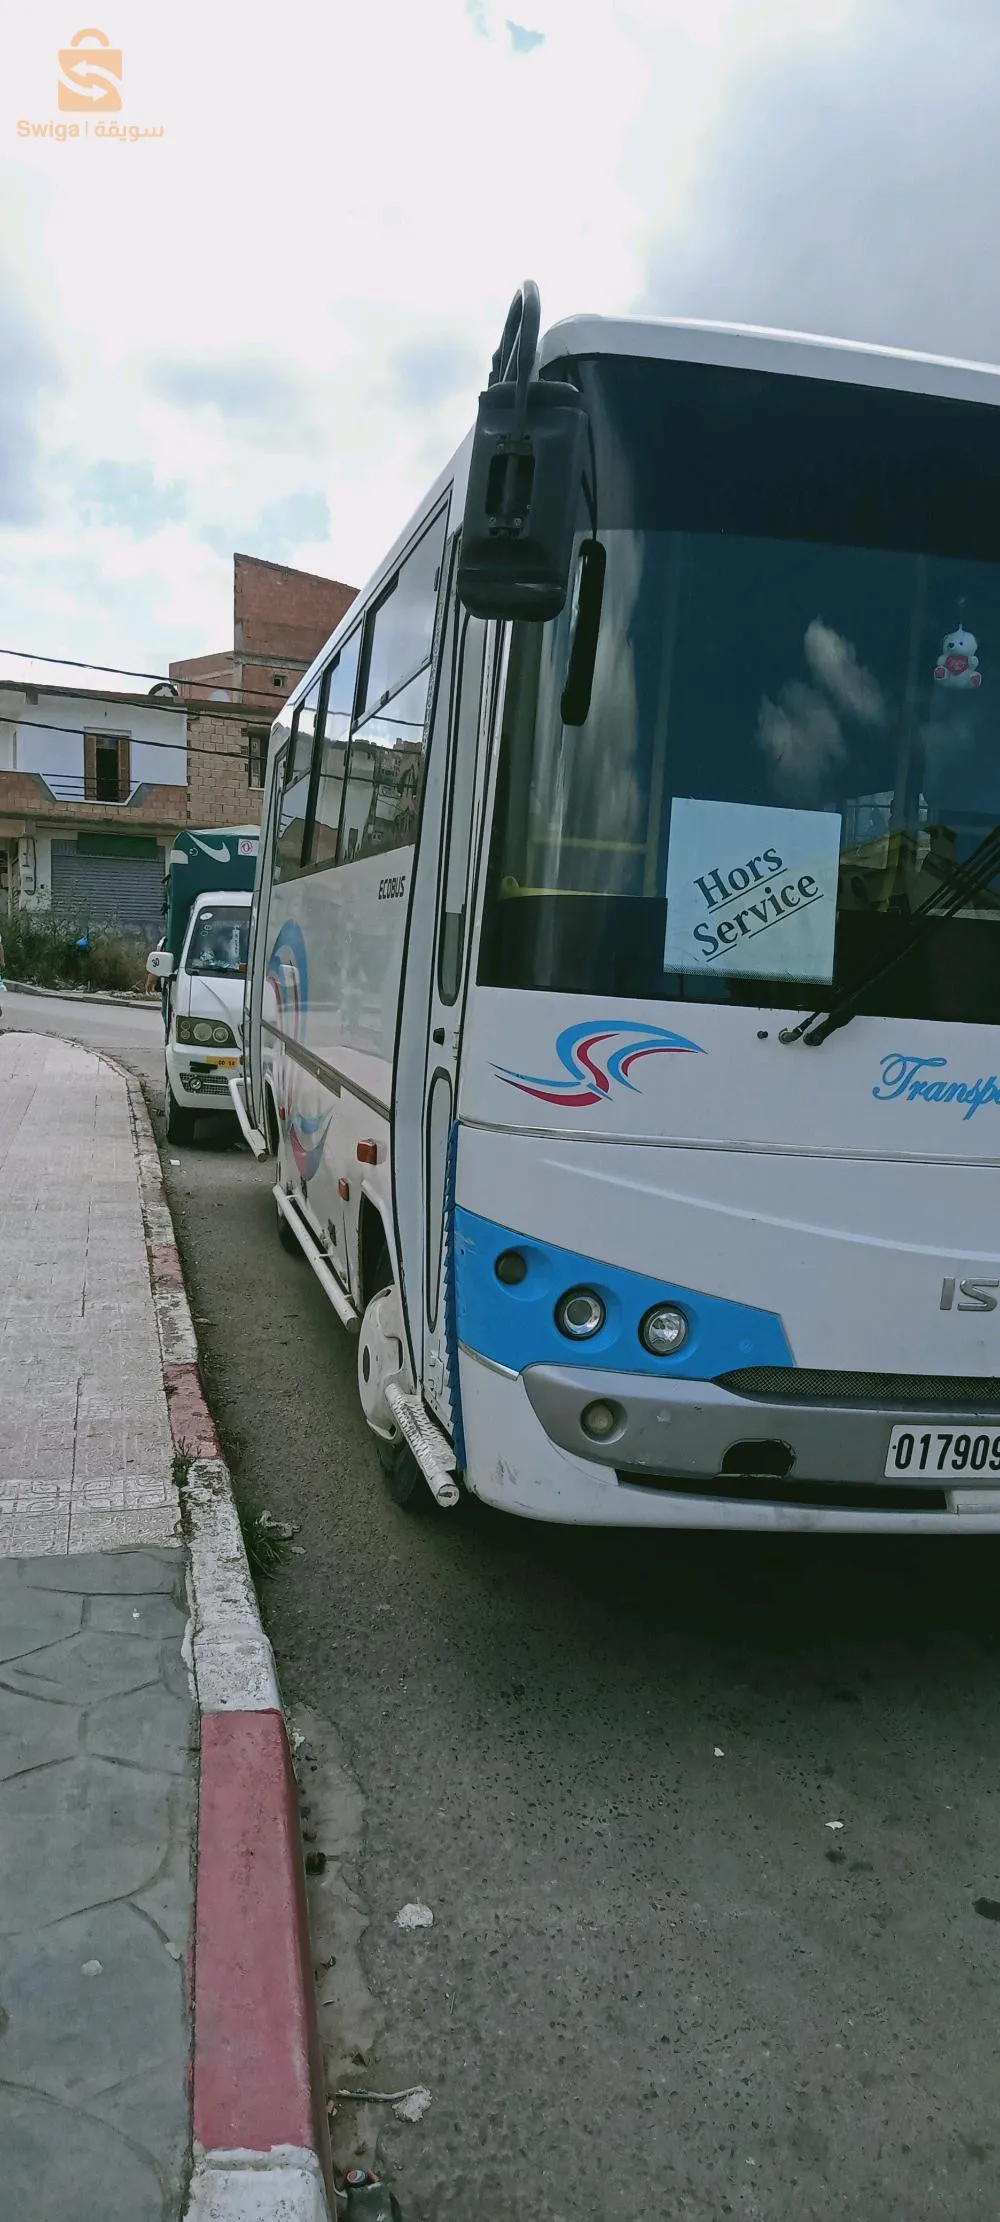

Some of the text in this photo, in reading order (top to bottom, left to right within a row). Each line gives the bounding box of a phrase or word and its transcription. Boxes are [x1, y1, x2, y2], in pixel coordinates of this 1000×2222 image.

[378, 875, 406, 900] ECOBUS
[693, 848, 785, 910] Hors
[692, 875, 820, 957] Service
